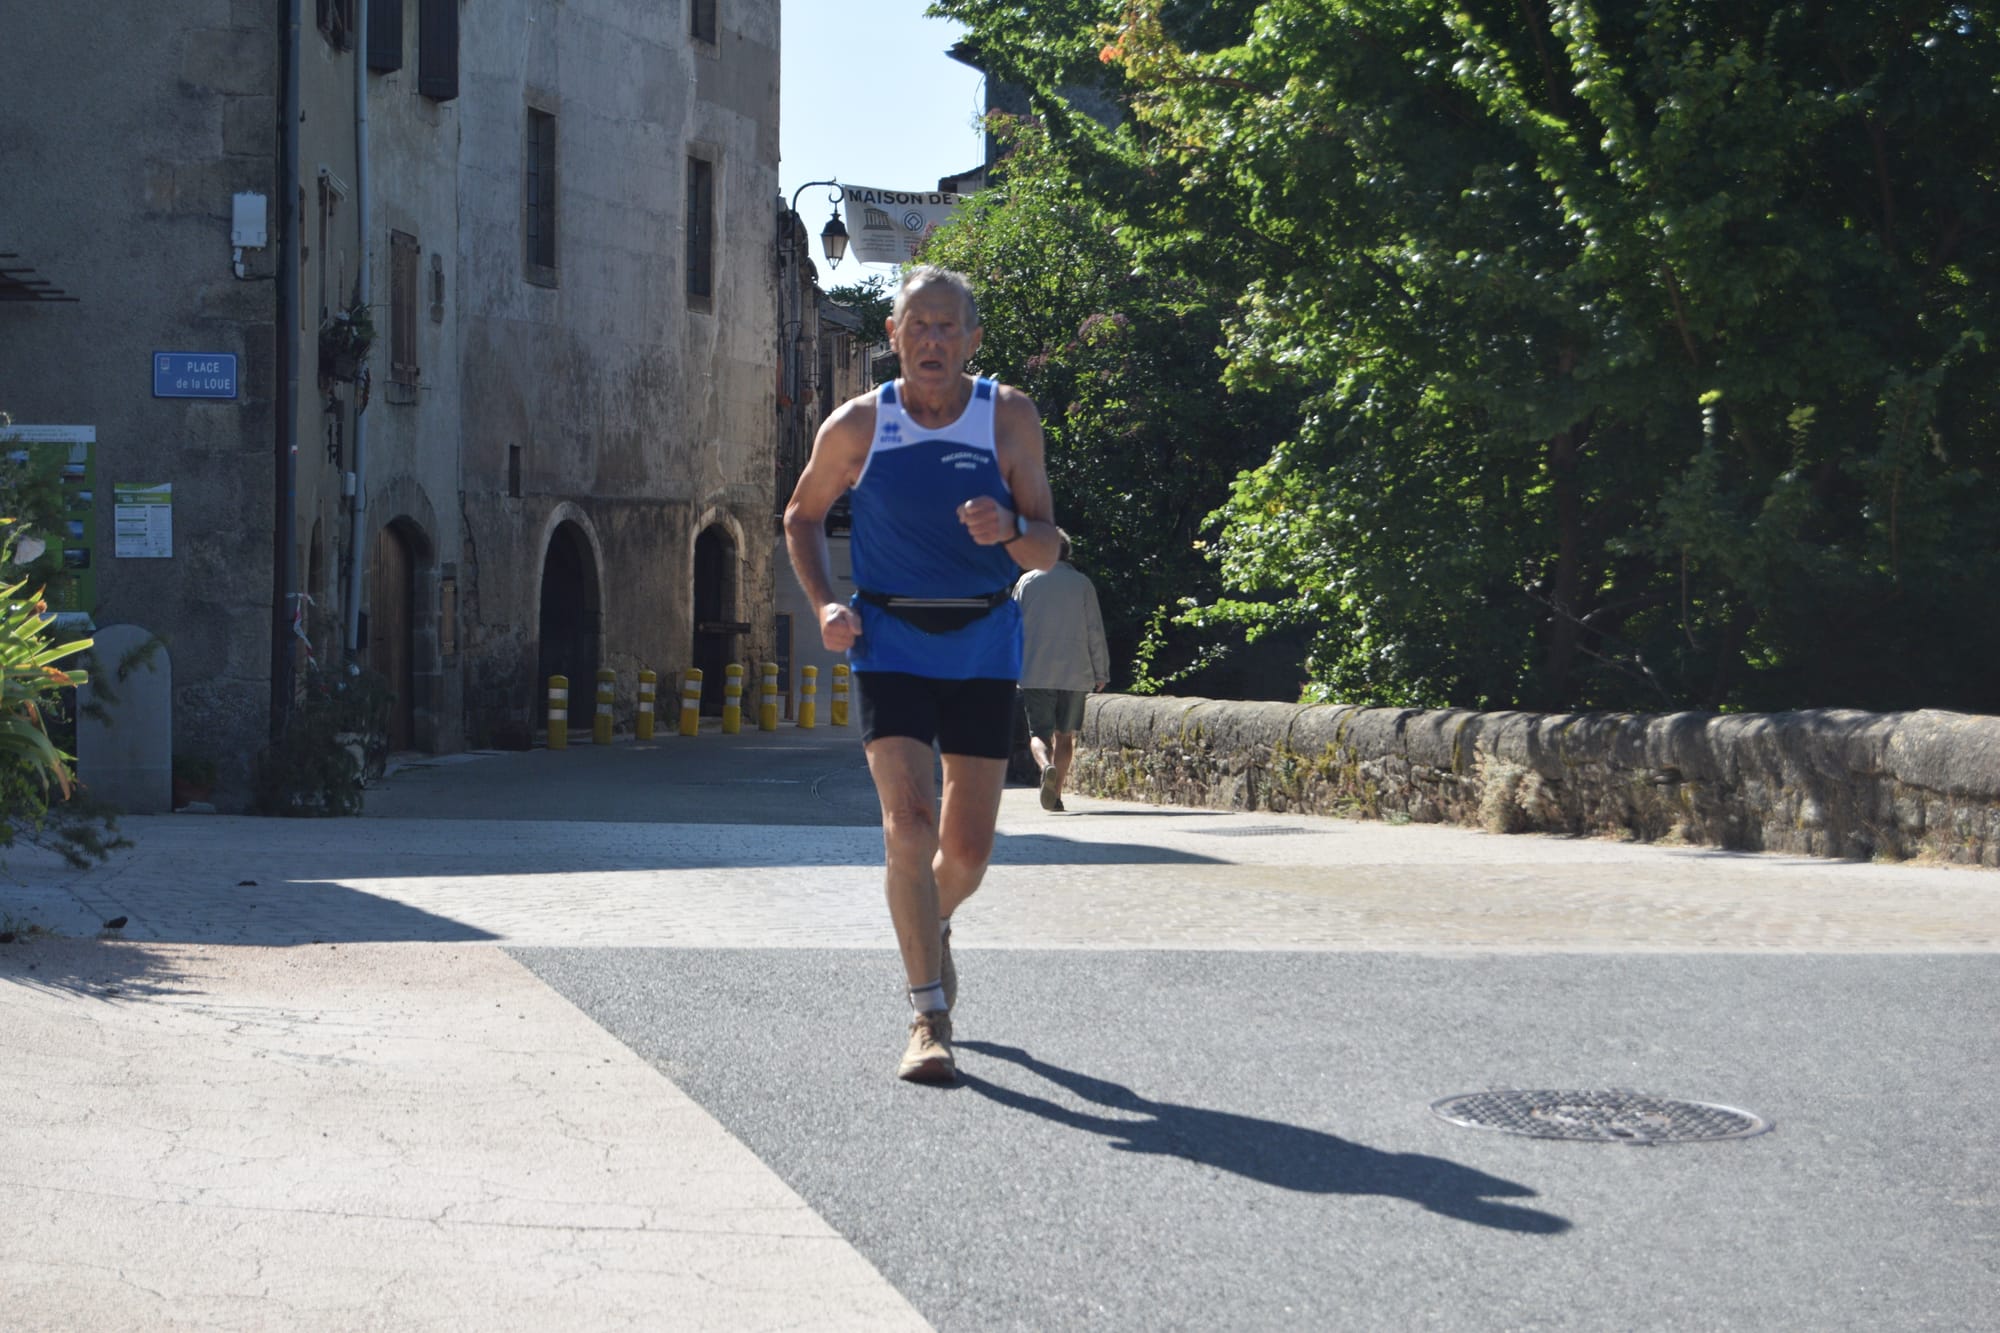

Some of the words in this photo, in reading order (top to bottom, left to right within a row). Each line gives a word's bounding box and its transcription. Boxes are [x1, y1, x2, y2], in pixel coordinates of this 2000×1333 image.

[848, 189, 922, 205] MAISON
[929, 193, 953, 205] DE
[187, 361, 220, 373] PLACE
[176, 378, 188, 389] de
[191, 379, 200, 389] la
[204, 379, 231, 390] LOUE
